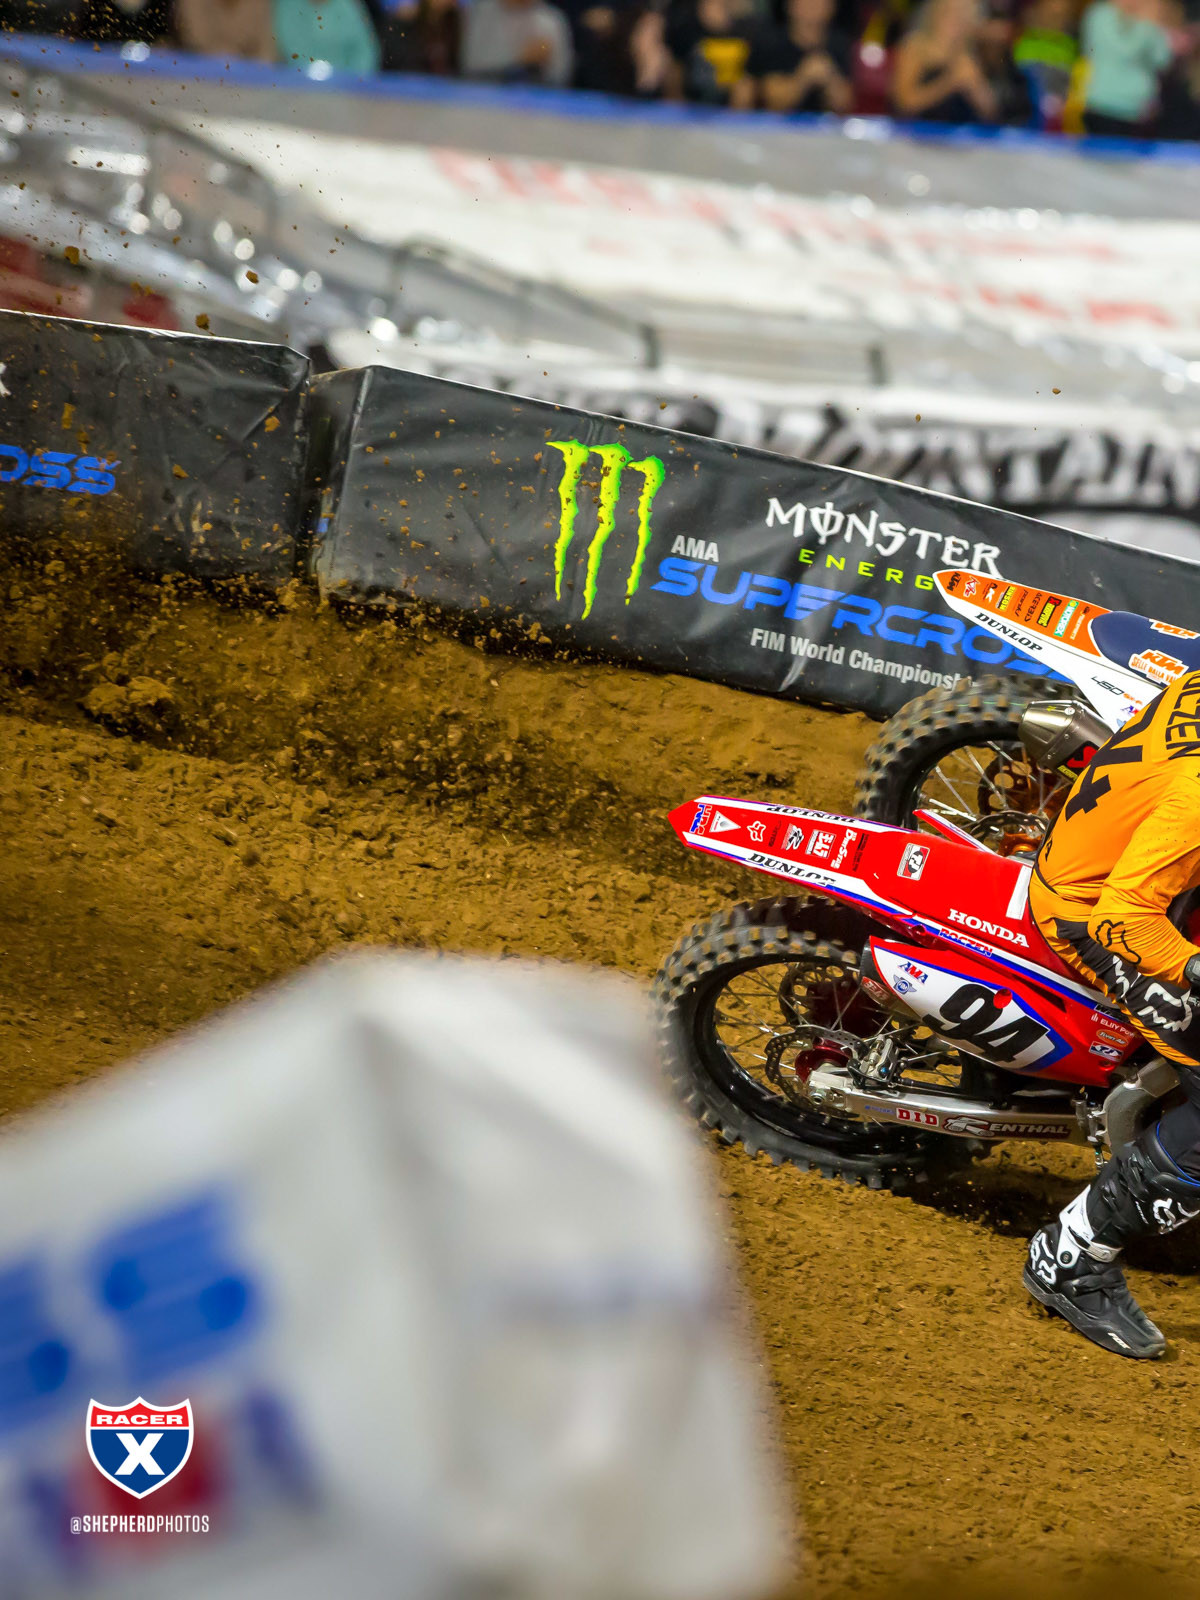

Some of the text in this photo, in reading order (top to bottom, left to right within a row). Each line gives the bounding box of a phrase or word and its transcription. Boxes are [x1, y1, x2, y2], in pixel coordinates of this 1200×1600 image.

[671, 534, 720, 563] AMA
[765, 496, 1003, 580] MONSTER
[947, 571, 960, 592] KTM
[750, 628, 786, 653] FIM
[787, 636, 845, 665] World
[974, 612, 1043, 652] DUNLOP
[1141, 651, 1185, 675] KTM
[1091, 675, 1125, 696] 450
[938, 927, 993, 958] ROCZEN
[947, 908, 1030, 948] HONDA
[900, 961, 929, 984] AMA
[922, 983, 1051, 1063] 94
